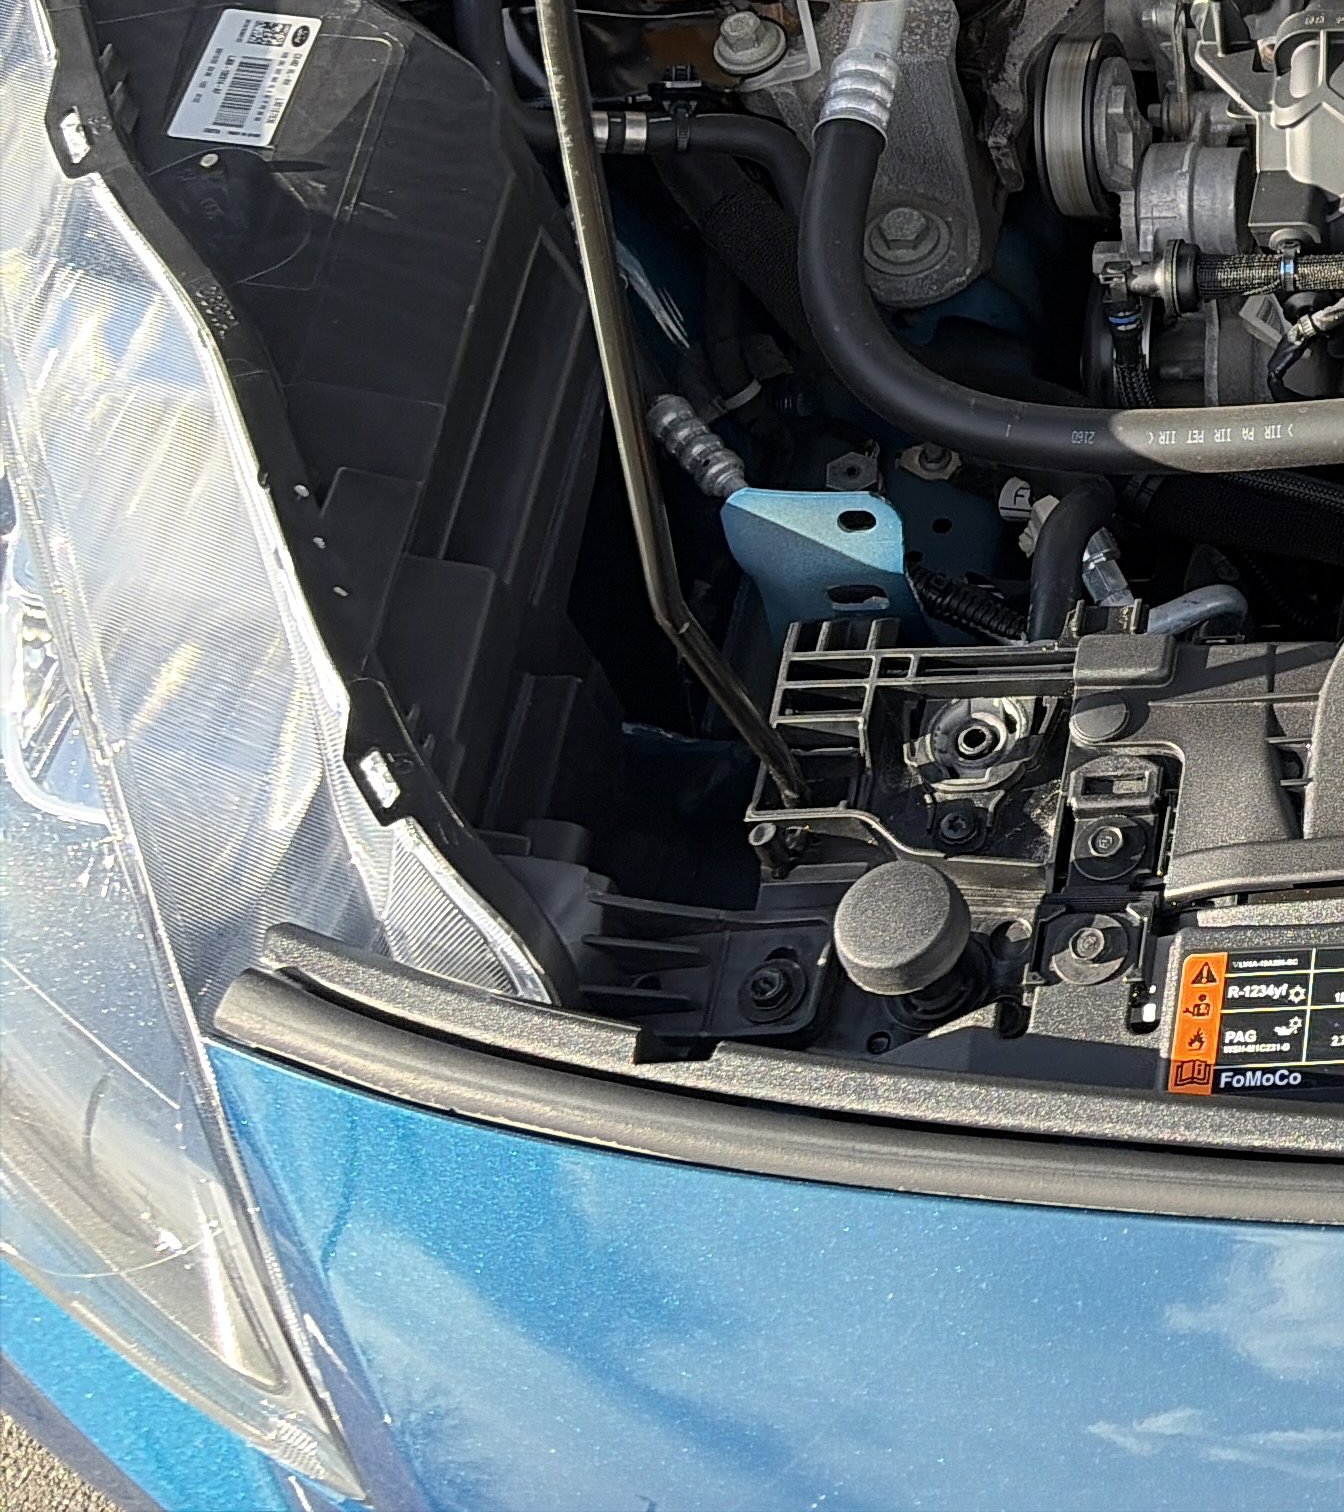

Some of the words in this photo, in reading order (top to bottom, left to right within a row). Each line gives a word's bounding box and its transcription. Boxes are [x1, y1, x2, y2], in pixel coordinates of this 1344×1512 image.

[1187, 429, 1205, 443] PET
[1242, 426, 1255, 440] PA
[1227, 984, 1288, 1000] R-1234yf
[1225, 1030, 1257, 1044] PAG
[1219, 1069, 1302, 1089] FoMoCo
